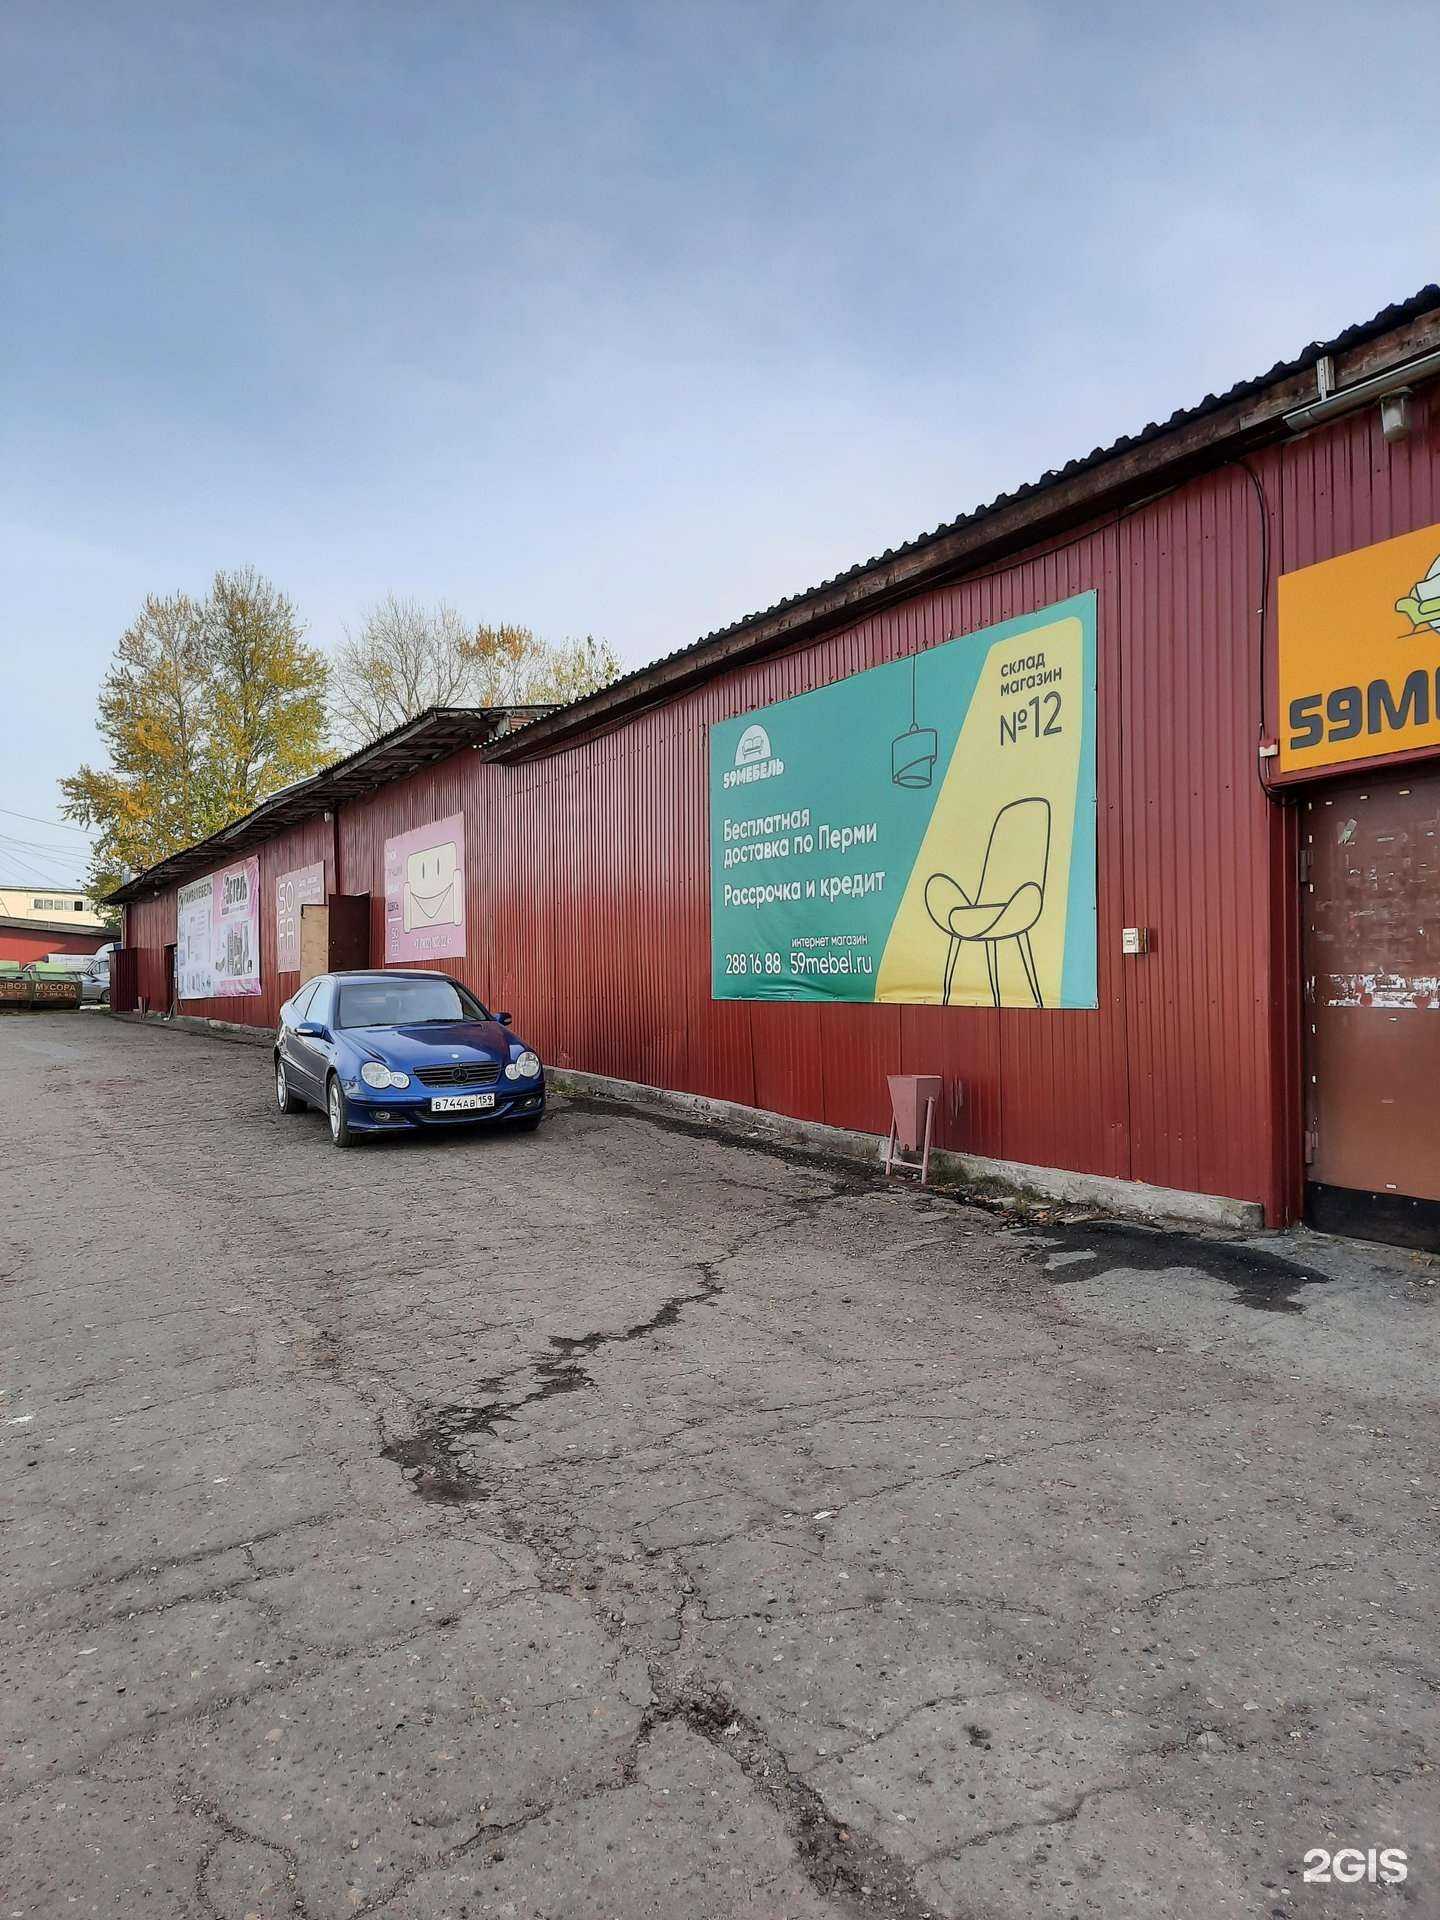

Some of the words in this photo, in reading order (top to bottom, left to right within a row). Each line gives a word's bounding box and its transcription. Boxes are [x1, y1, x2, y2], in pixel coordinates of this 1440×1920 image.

[1000, 652, 1046, 678] склад
[1000, 667, 1062, 697] магазин
[1000, 690, 1062, 746] №12
[1289, 664, 1440, 750] 59М
[723, 758, 784, 789] 59МЕБЕЛЬ
[723, 808, 810, 841] Бесплатная
[724, 837, 789, 869] доставка
[794, 834, 814, 854] по
[818, 823, 877, 853] Перми
[724, 881, 801, 909] Рассрочка
[806, 880, 815, 898] и
[820, 871, 886, 903] кредит
[791, 936, 829, 950] интернет
[831, 935, 868, 947] магазин
[725, 953, 747, 974] 288
[750, 953, 762, 974] 16
[765, 952, 782, 974] 88
[790, 950, 873, 974] 59mebel.ru
[35, 983, 76, 992] МУСОРА
[478, 1095, 493, 1104] 159
